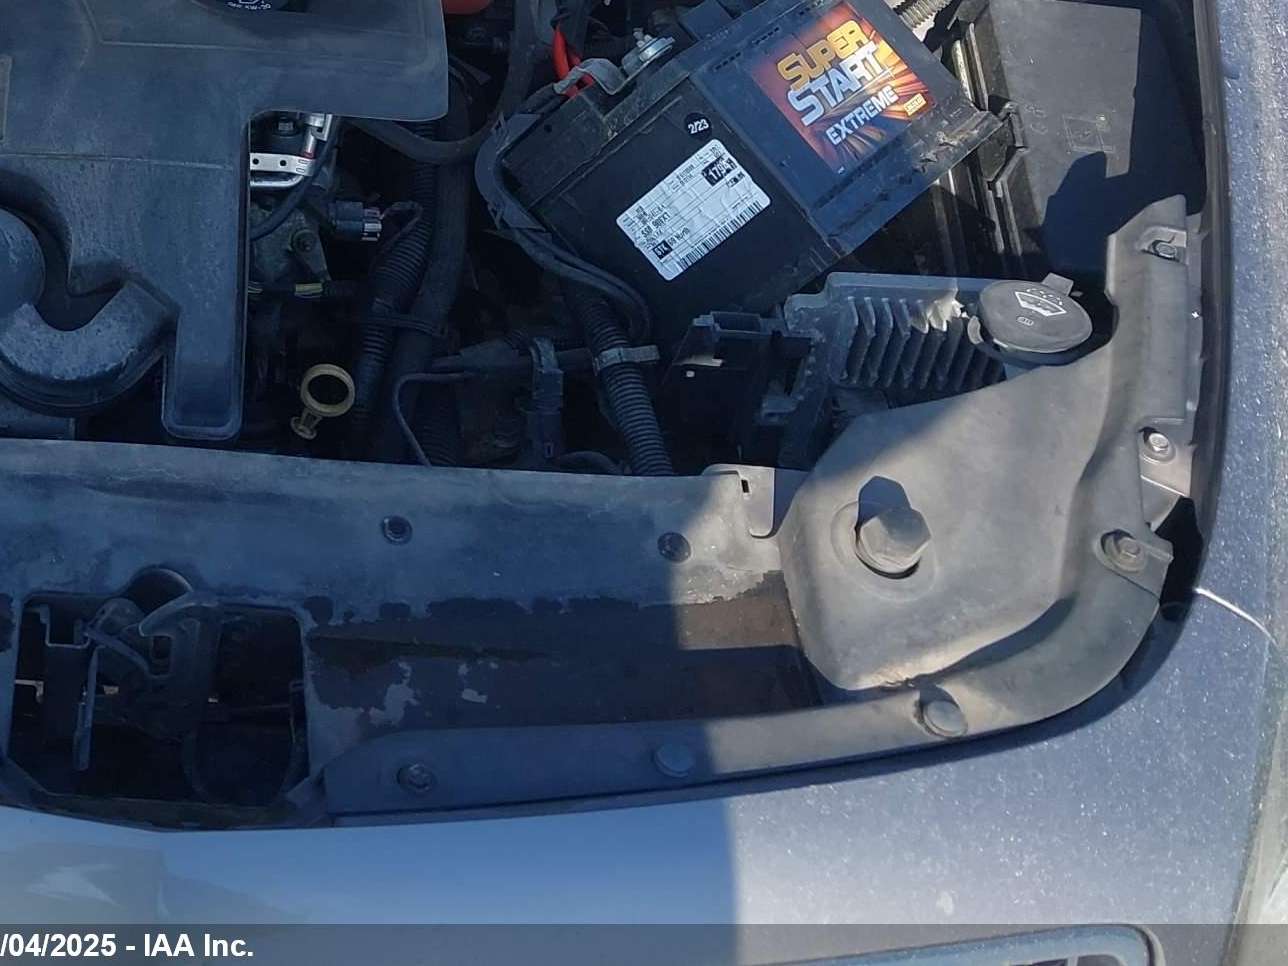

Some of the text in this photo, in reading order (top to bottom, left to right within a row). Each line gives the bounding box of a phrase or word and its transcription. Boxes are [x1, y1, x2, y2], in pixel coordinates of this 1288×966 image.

[777, 20, 869, 90] SUPER
[787, 43, 887, 126] START
[688, 118, 710, 135] 2/23
[826, 85, 899, 146] EXTREME
